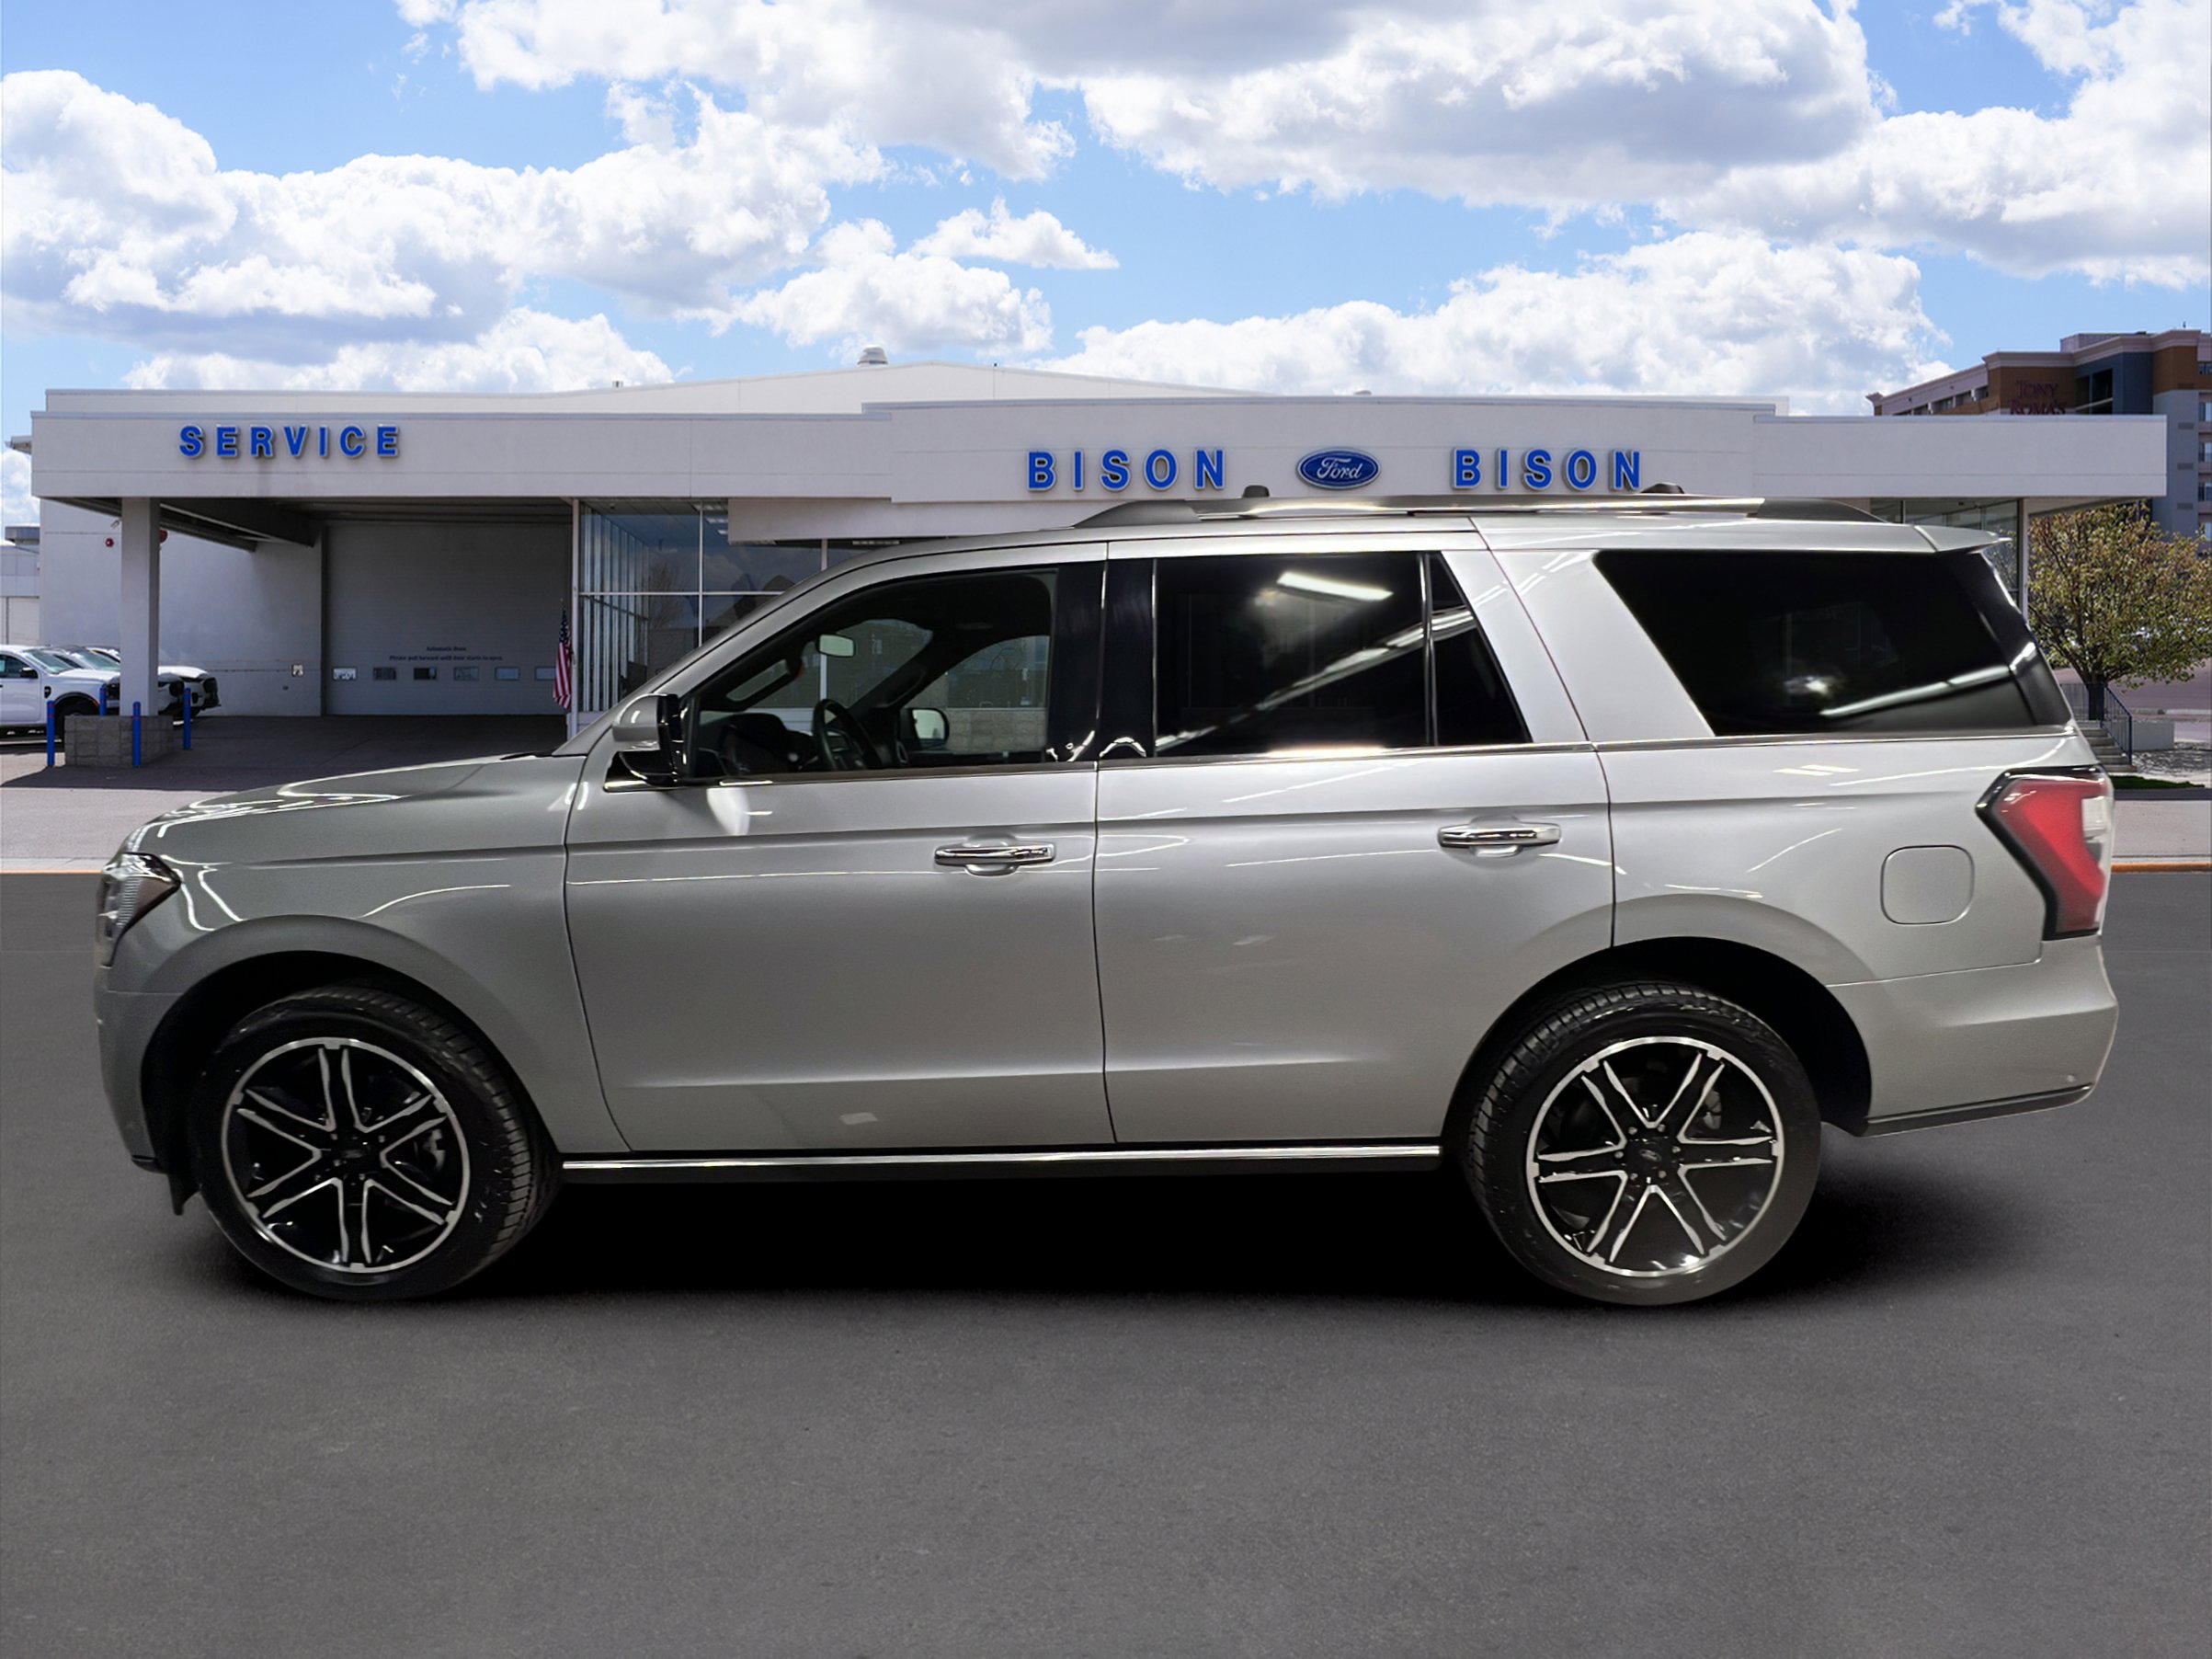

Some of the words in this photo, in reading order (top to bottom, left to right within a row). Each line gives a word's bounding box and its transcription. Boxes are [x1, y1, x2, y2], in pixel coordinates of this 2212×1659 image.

[2015, 379, 2058, 398] TONY
[179, 425, 400, 458] SERVICE
[1027, 448, 1226, 491] BISON
[1317, 457, 1363, 479] Ford
[1452, 448, 1642, 490] BISON
